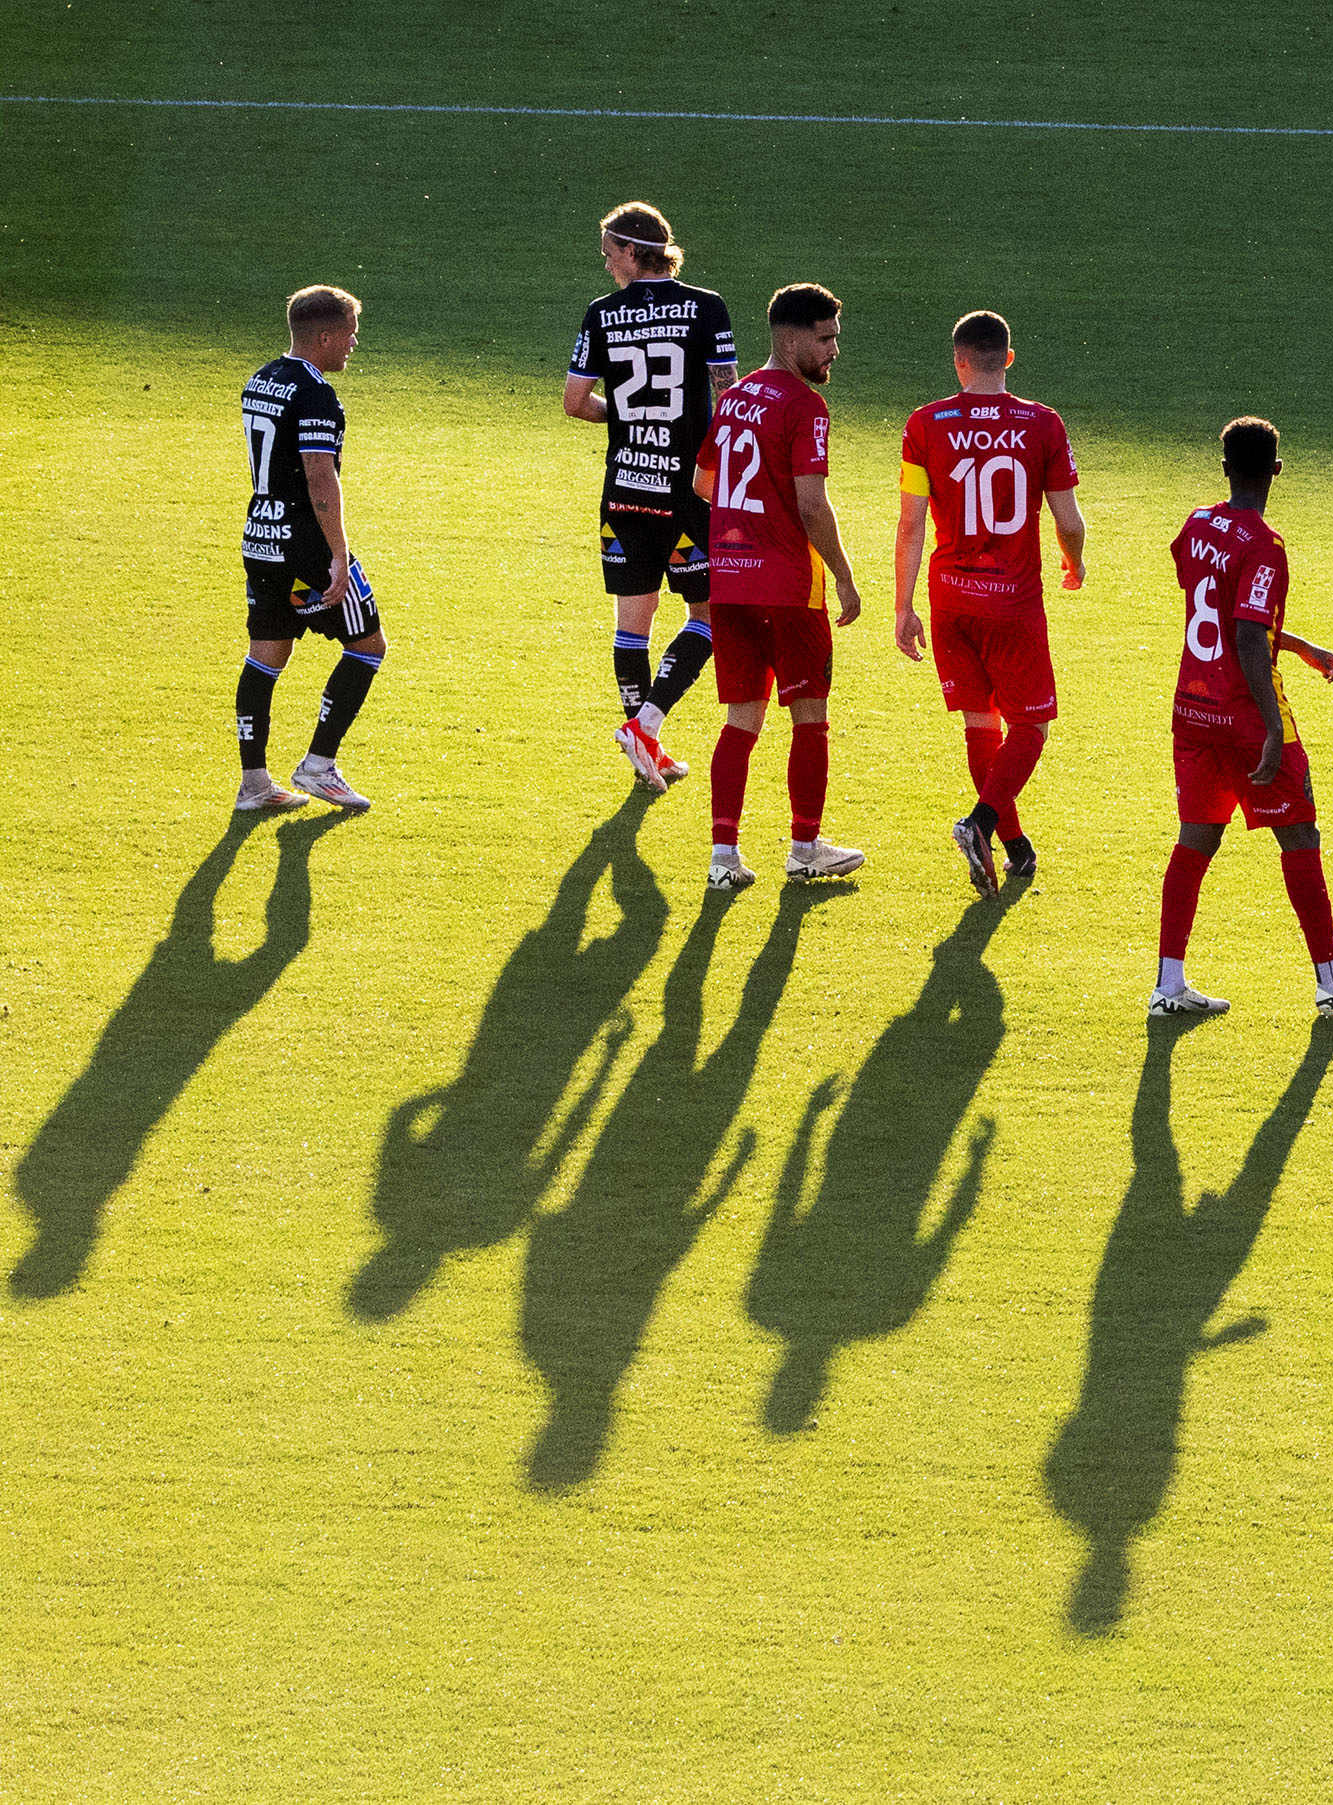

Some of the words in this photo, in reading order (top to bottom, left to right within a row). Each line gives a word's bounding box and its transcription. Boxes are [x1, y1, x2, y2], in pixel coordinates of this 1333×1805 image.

[600, 299, 698, 328] Infrakraft
[606, 324, 689, 344] BRASSERIET
[607, 342, 685, 422] 23
[970, 406, 1000, 419] OBK
[947, 430, 1027, 450] WOKK
[615, 468, 671, 487] BYGGSTÅL
[714, 425, 765, 514] 12
[949, 455, 1027, 536] 10
[244, 516, 292, 540] ÖJDENS
[601, 552, 627, 564] mudden
[940, 573, 1018, 593] WALLENSTEDT
[1187, 575, 1224, 662] 8
